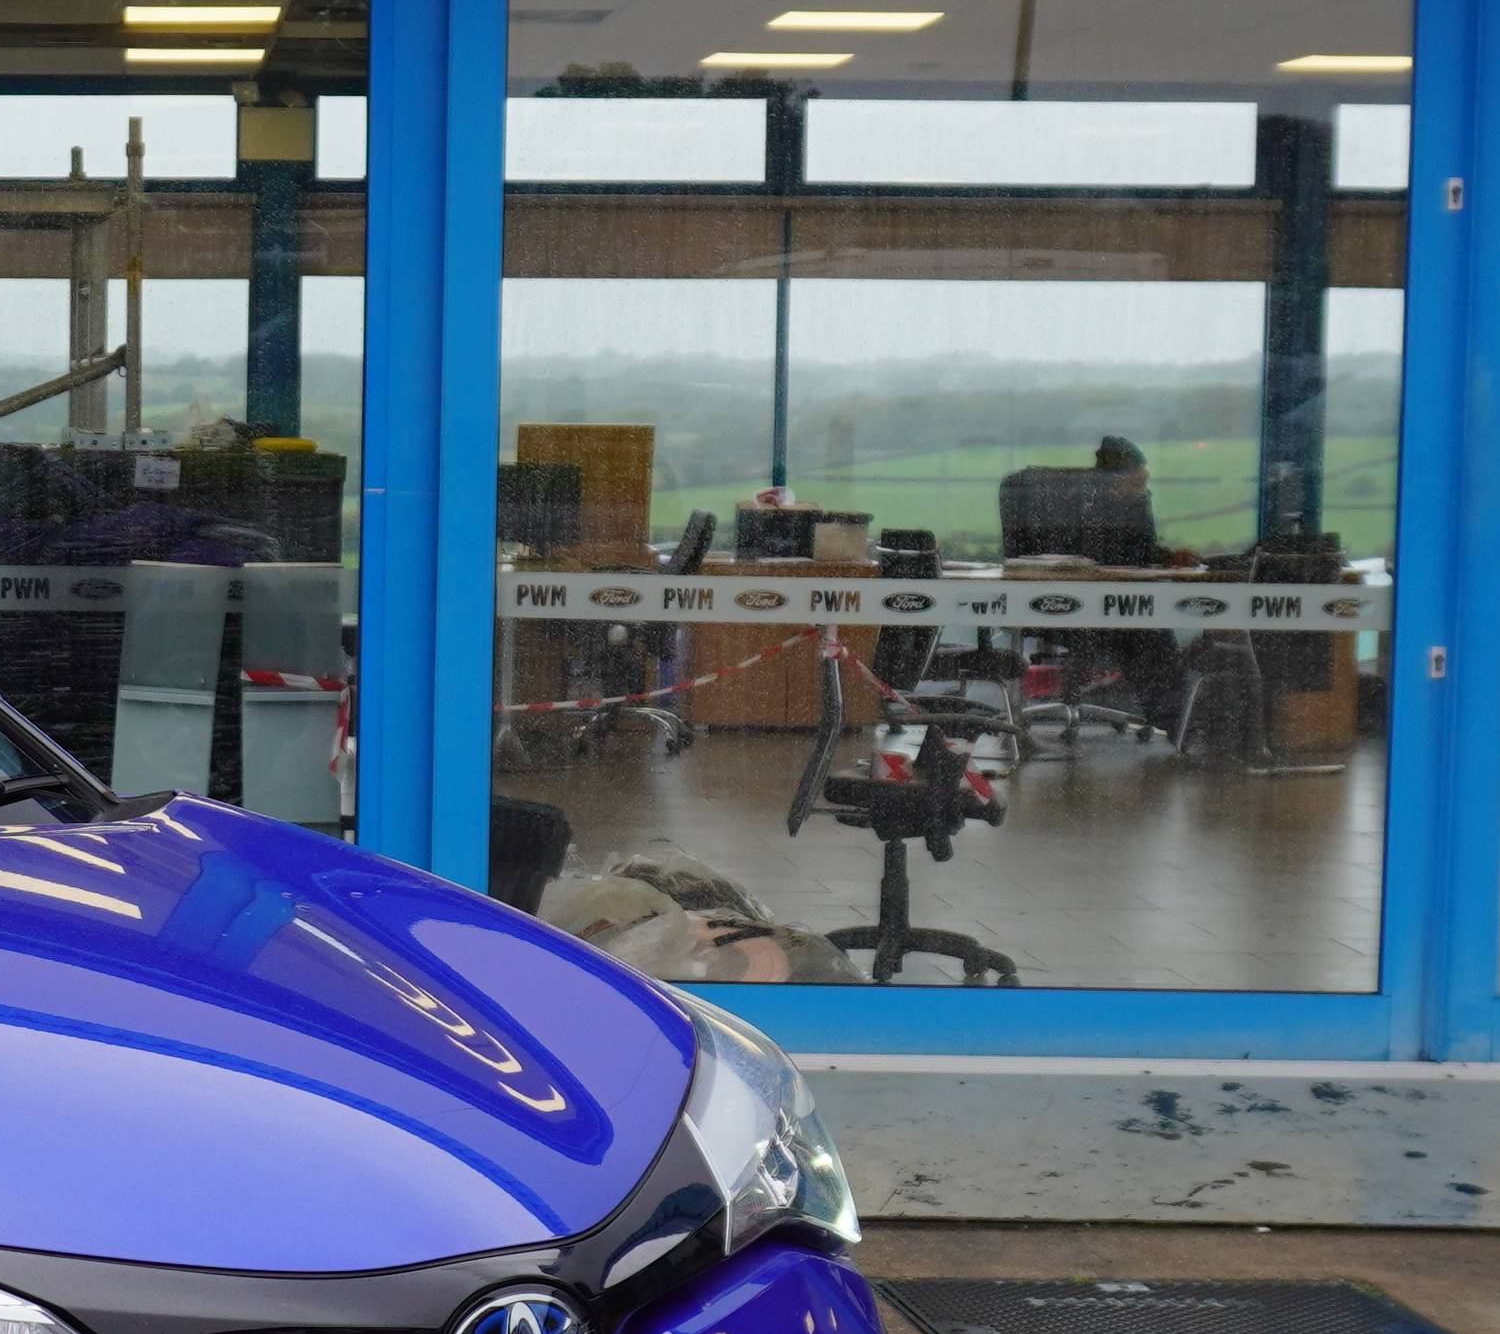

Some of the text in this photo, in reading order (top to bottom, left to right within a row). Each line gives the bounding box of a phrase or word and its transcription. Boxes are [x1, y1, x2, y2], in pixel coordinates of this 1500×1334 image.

[0, 577, 50, 599] PWM
[515, 584, 568, 607] PWM
[663, 587, 714, 610] PWM
[810, 590, 861, 613] PWM
[1104, 594, 1154, 616] PWM
[1251, 596, 1302, 618] PWM
